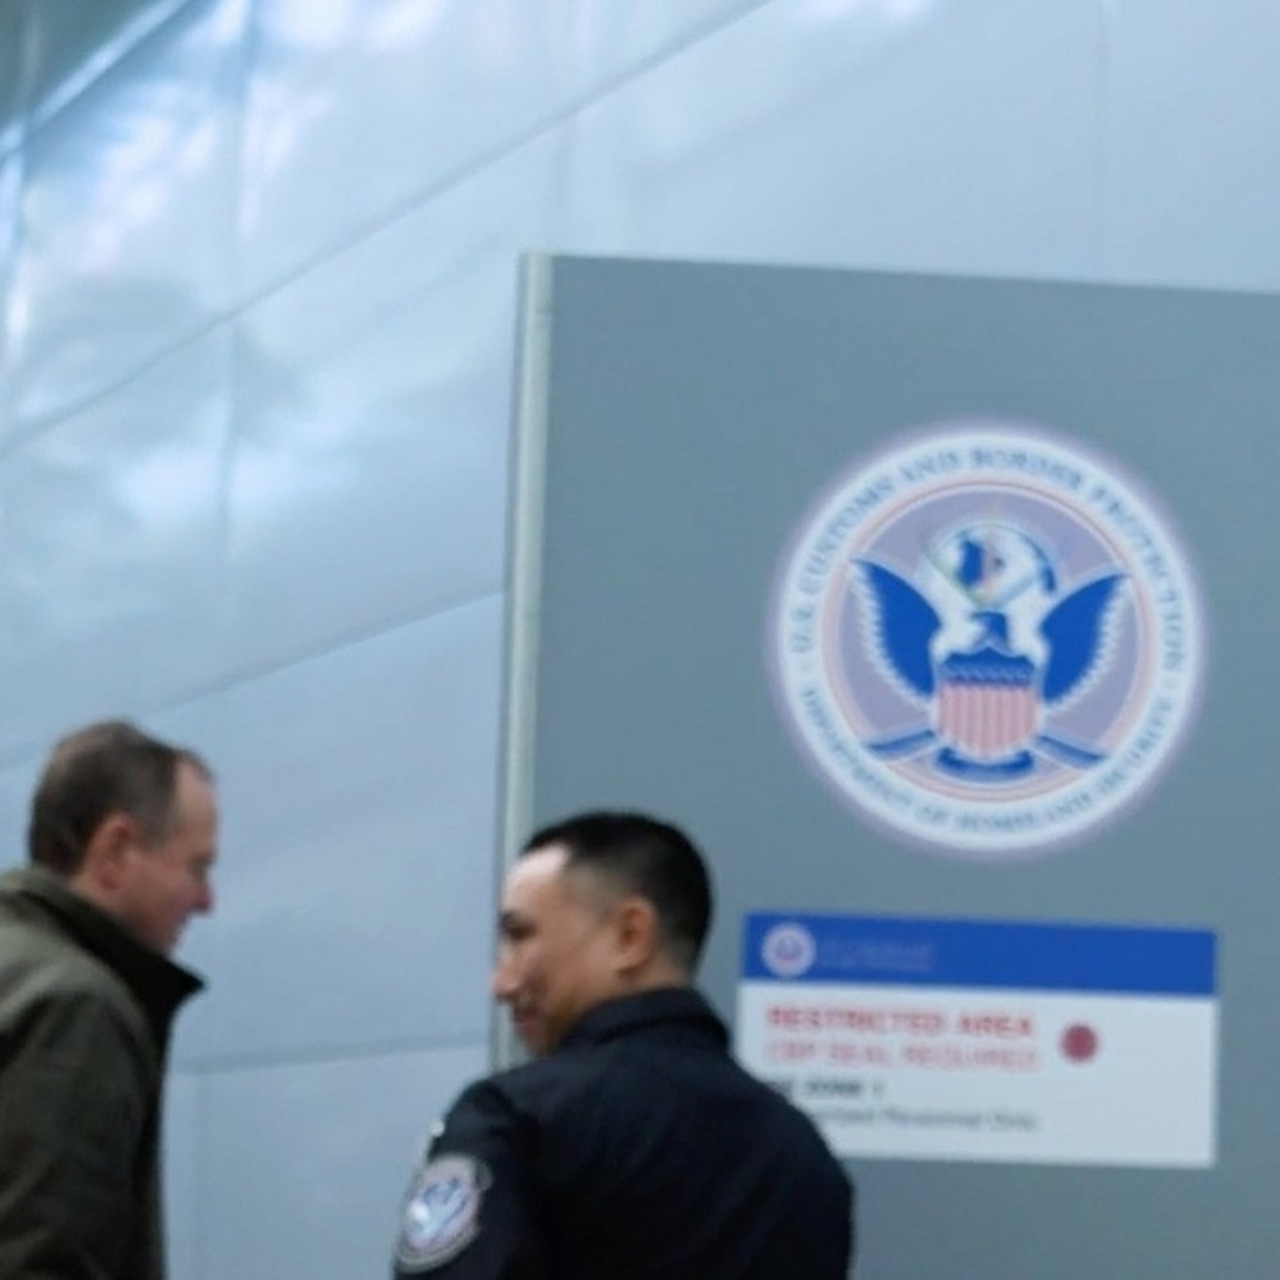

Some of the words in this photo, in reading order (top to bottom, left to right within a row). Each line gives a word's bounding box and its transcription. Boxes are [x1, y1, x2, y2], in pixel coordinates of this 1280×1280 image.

[798, 475, 896, 597] CUSTOMS
[900, 448, 960, 484] AND
[972, 448, 1084, 490] BORDER
[1088, 484, 1186, 673] PROTECTION
[767, 1006, 946, 1036] RESTRICTED
[957, 1012, 1034, 1038] AREA
